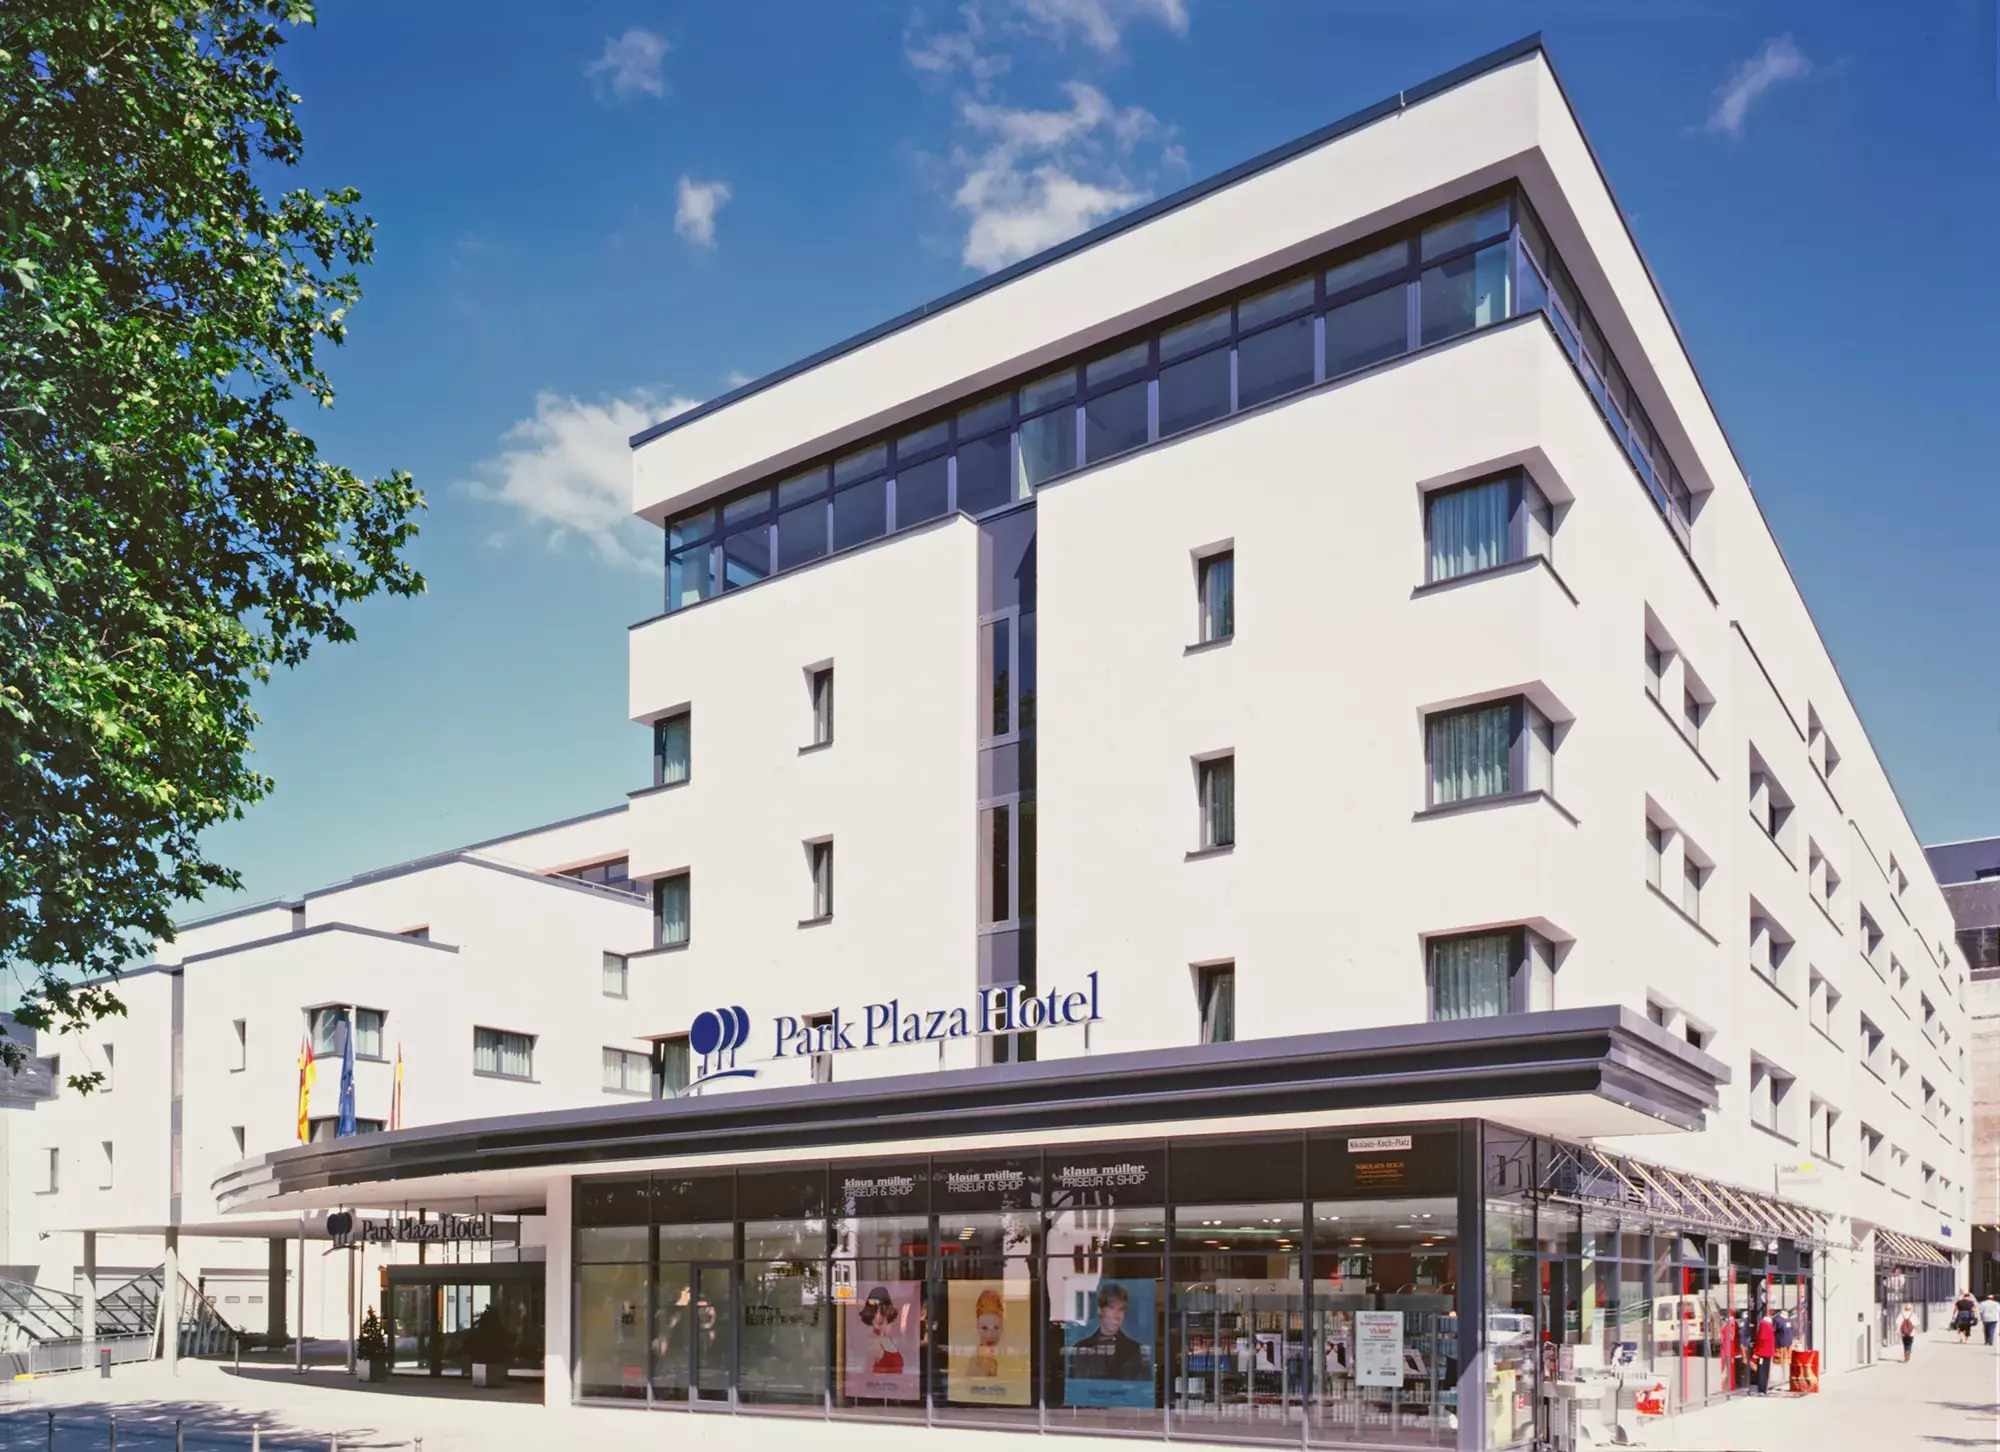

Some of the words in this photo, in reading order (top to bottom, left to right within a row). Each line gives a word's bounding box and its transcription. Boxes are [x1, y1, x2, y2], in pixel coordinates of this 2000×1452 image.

[773, 1006, 856, 1058] Park
[862, 999, 972, 1047] Plaza
[977, 970, 1102, 1033] Hotel
[1349, 1139, 1410, 1149] Nikolaus-Koch-Platz
[949, 1173, 981, 1182] klaus
[984, 1170, 1023, 1180] müller
[1062, 1166, 1098, 1177] klaus
[1102, 1163, 1145, 1174] müller
[844, 1178, 873, 1188] klaus
[877, 1176, 913, 1186] müller
[948, 1181, 985, 1193] FRISEUR
[987, 1180, 995, 1191] &
[997, 1179, 1023, 1190] SHOP
[1062, 1176, 1103, 1188] FRISEUR
[1106, 1175, 1114, 1186] &
[1117, 1174, 1146, 1185] SHOP
[844, 1187, 878, 1198] FRISEUR
[880, 1187, 887, 1196] &
[889, 1185, 913, 1196] SHOP
[361, 1217, 394, 1240] Park
[399, 1217, 439, 1240] Plaza
[442, 1213, 488, 1239] Hotel
